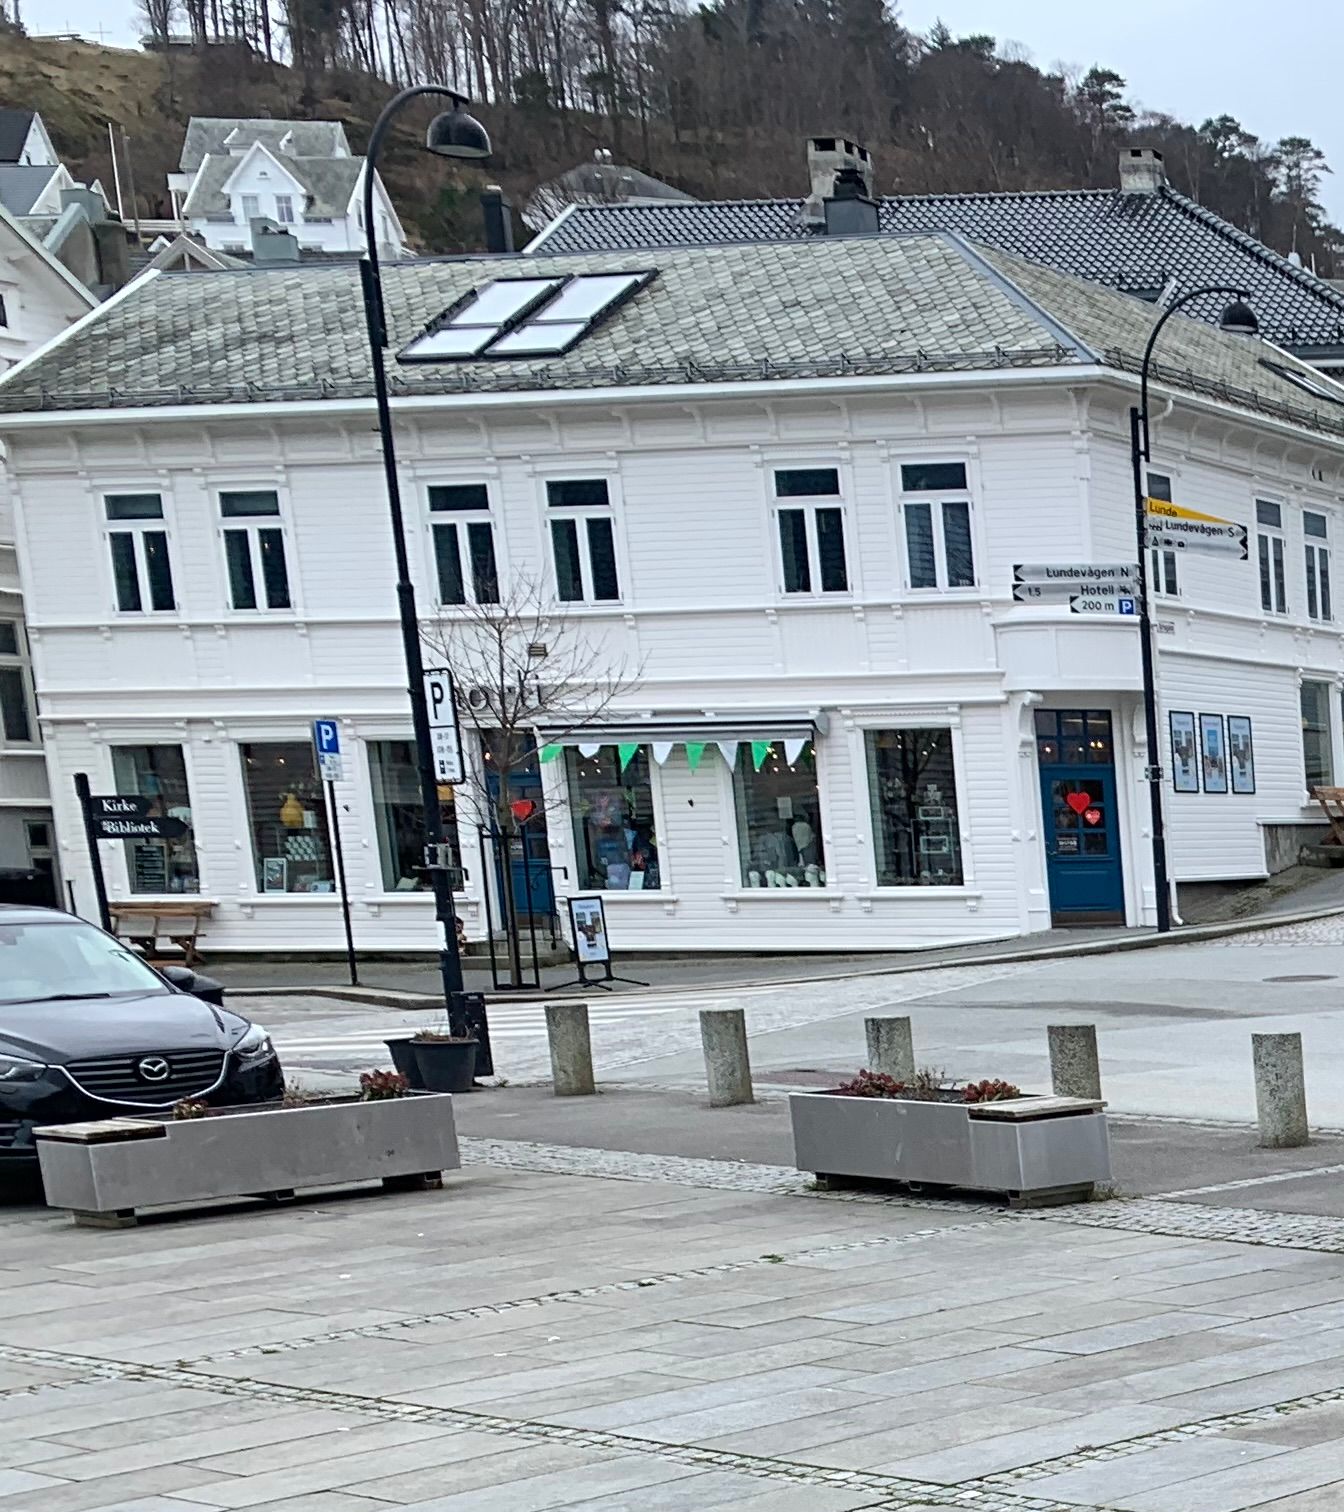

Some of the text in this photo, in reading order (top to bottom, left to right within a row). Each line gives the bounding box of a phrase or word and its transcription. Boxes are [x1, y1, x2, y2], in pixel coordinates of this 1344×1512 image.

[1150, 502, 1178, 517] Lunde
[1166, 520, 1223, 536] Lundevågen
[1046, 566, 1129, 579] Lundevågen N
[1081, 585, 1114, 596] Hotell
[1082, 600, 1131, 613] 200 m P
[430, 682, 444, 720] P
[320, 725, 334, 750] P
[102, 799, 138, 812] Kirke
[106, 820, 160, 833] Bibliotek
